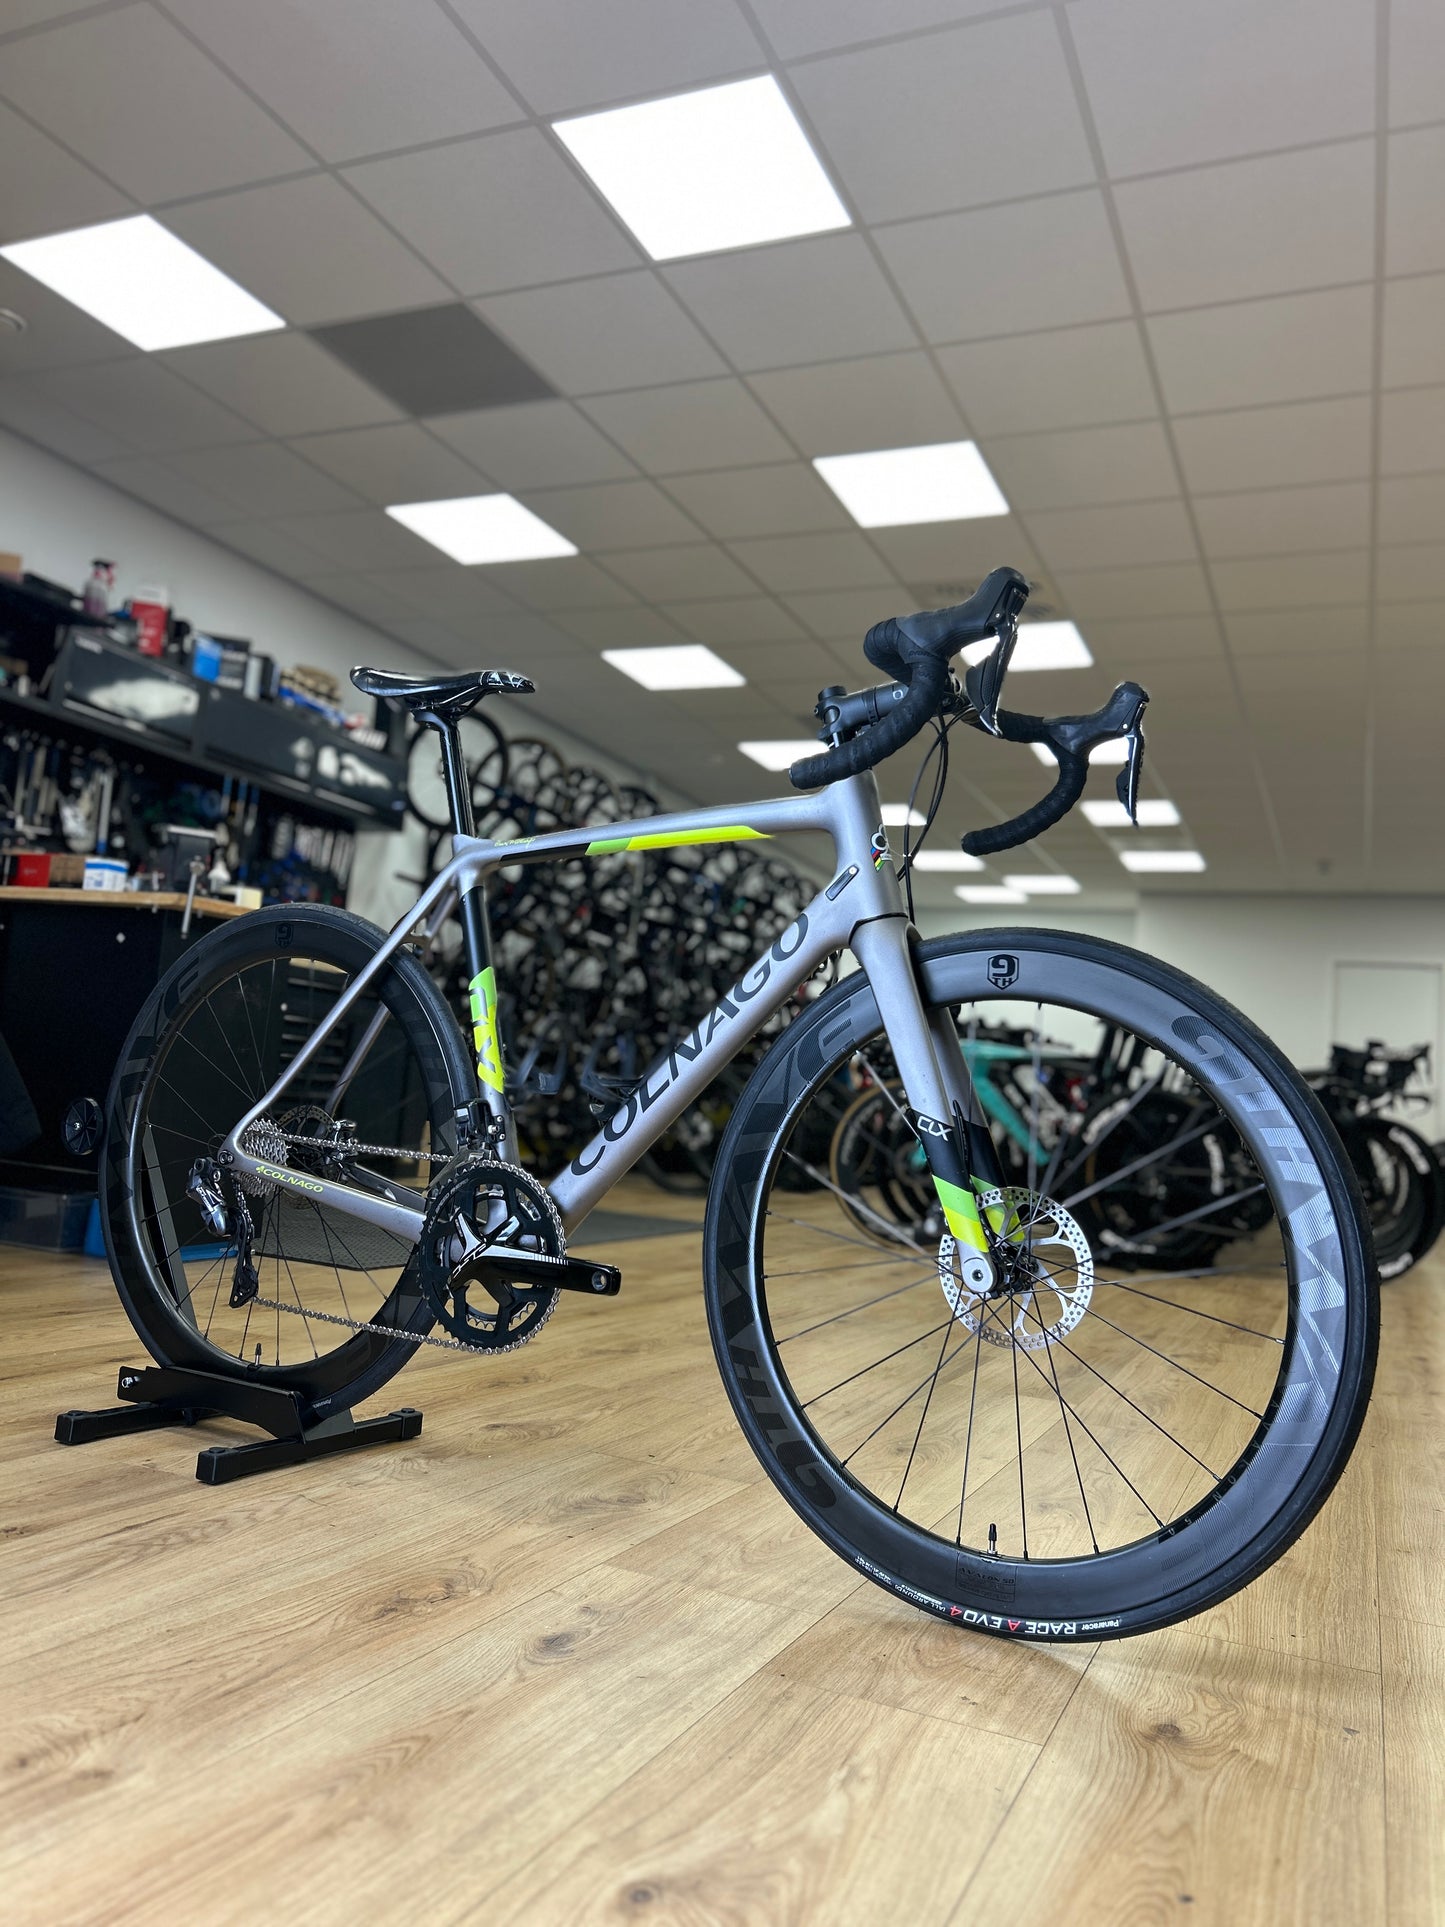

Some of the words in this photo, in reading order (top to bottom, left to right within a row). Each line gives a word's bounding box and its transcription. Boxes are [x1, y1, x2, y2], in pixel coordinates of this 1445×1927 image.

[991, 954, 1016, 978] 9
[570, 912, 809, 1176] COLNAGO
[263, 1168, 324, 1193] COLNAGO
[1007, 1619, 1021, 1632] A
[1024, 1621, 1077, 1635] RACE
[1081, 1619, 1120, 1631] Panaracer
